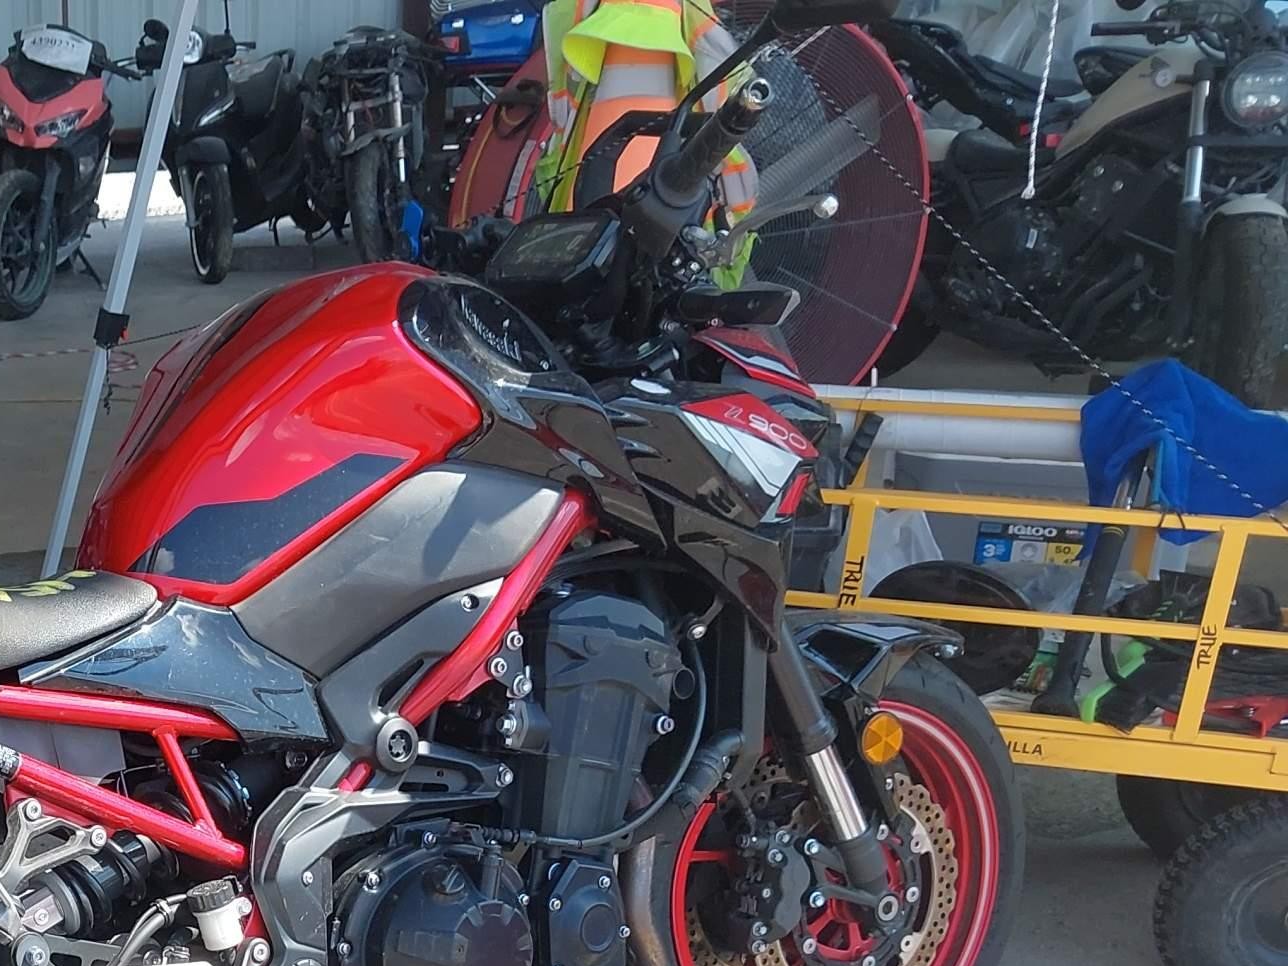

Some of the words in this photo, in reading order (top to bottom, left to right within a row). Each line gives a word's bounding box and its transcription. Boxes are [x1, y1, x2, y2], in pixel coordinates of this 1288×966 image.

[748, 413, 808, 450] 900
[1008, 524, 1057, 537] IGLOO
[1196, 623, 1218, 670] TRUE
